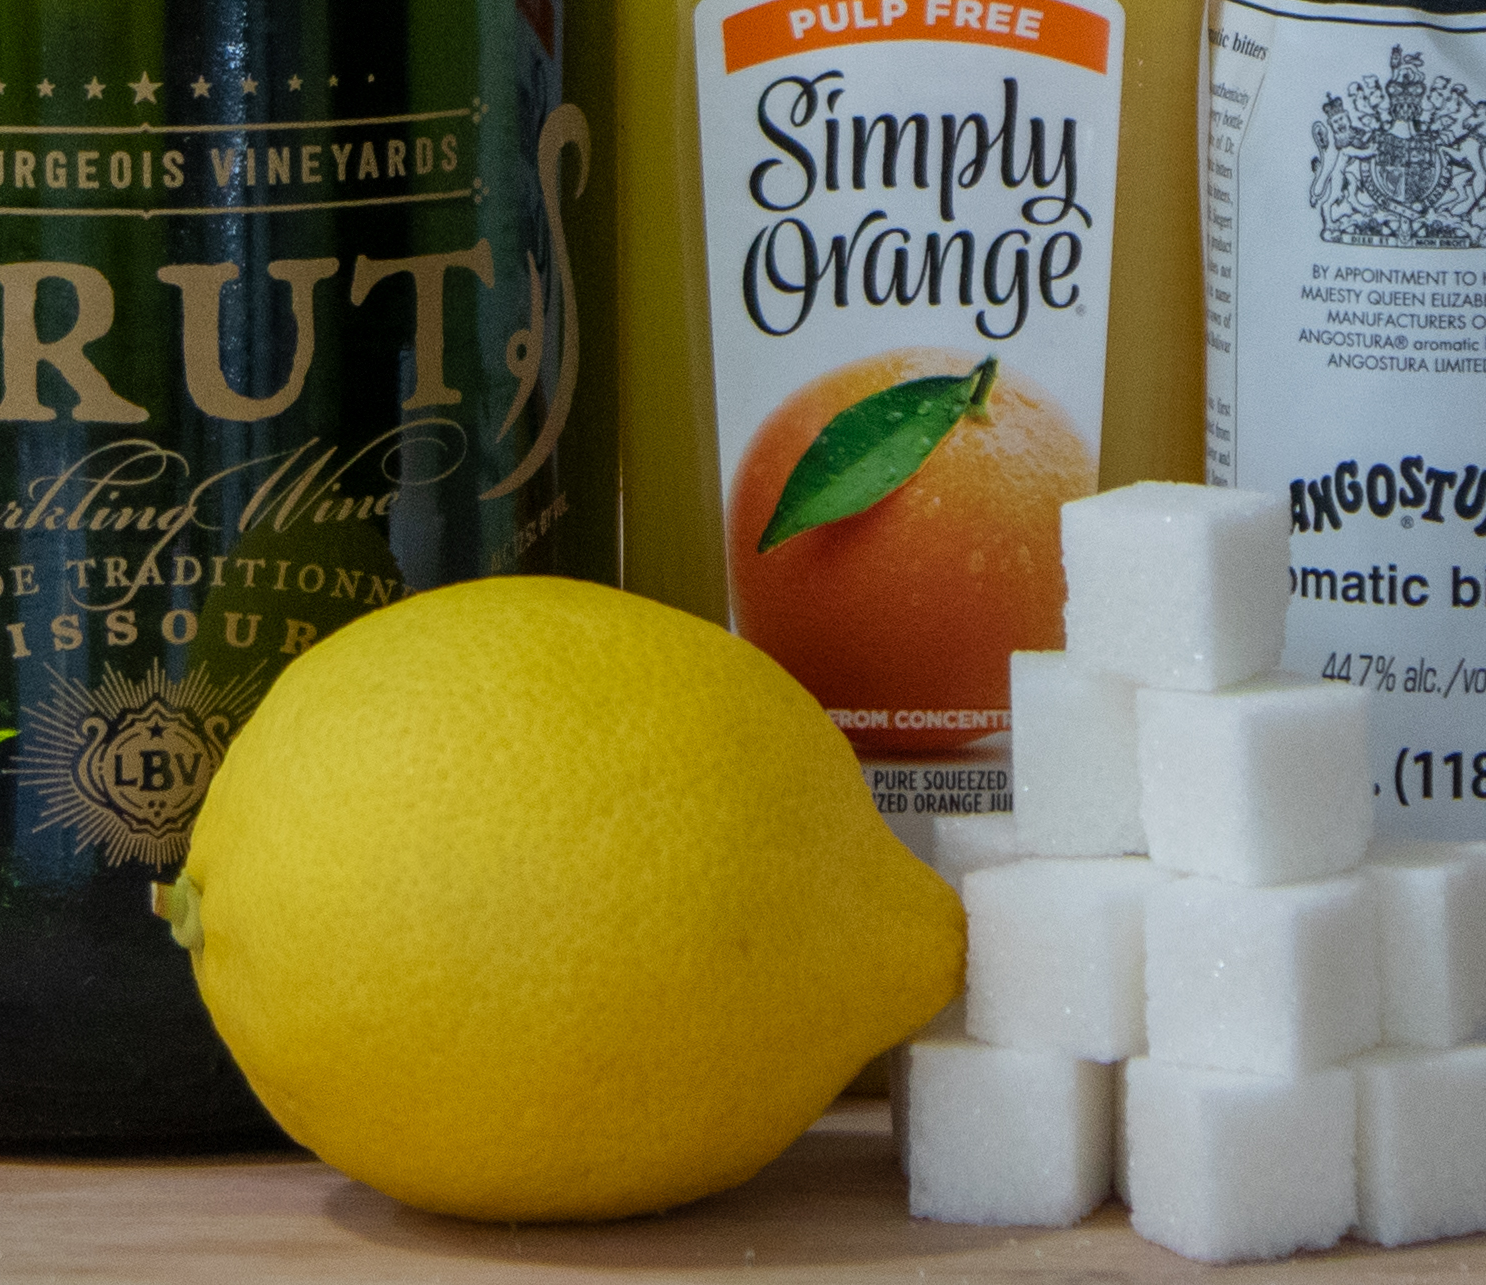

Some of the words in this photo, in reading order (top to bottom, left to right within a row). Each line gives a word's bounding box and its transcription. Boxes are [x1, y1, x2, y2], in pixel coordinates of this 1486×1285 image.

[1232, 32, 1268, 62] bitters
[212, 133, 460, 188] VINEYARDS
[749, 69, 1093, 230] Simply
[742, 209, 1084, 340] Orange
[1312, 263, 1330, 280] BY
[1334, 266, 1448, 286] APPOINTMENT
[1453, 270, 1478, 287] TO
[1301, 285, 1363, 304] MAJESTY
[1367, 290, 1425, 307] QUEEN
[1326, 309, 1466, 330] MANUFACTURERS
[1298, 328, 1409, 351] ANGOSTURA®
[1413, 338, 1480, 352] aromatic
[1327, 353, 1430, 373] ANGOSTURA
[190, 417, 468, 533] Wine
[114, 749, 204, 792] LBV
[874, 770, 918, 791] PURE
[923, 770, 1008, 791] SQUEEZED
[914, 793, 982, 814] ORANGE
